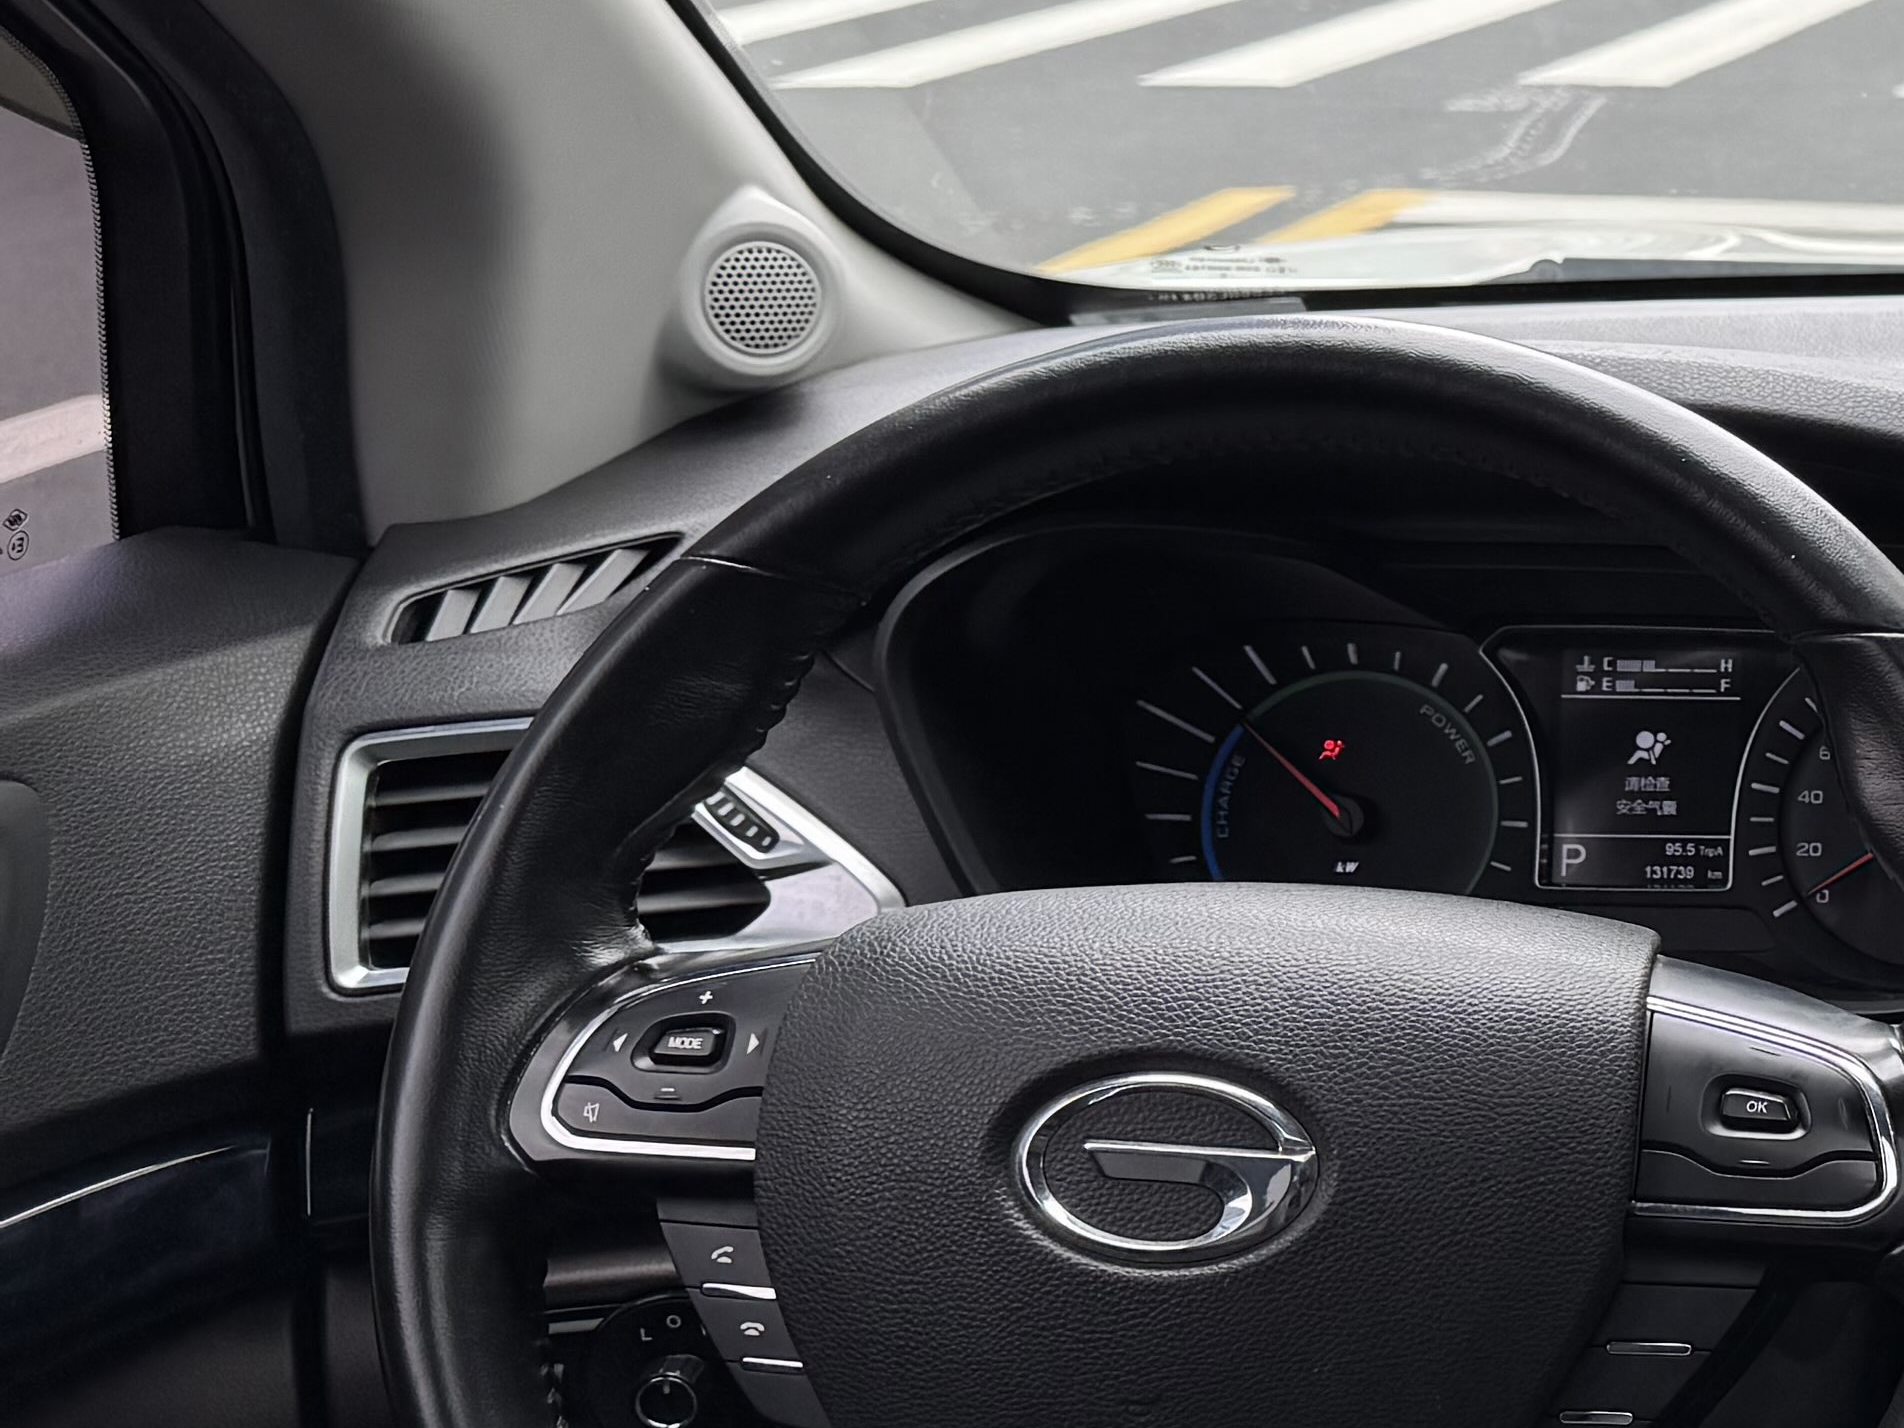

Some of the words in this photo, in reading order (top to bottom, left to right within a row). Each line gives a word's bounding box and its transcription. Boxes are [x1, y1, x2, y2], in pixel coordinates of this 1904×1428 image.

[1602, 656, 1615, 672] C
[1720, 657, 1734, 673] H
[1602, 677, 1614, 692] E
[1720, 678, 1732, 693] F
[1417, 703, 1477, 766] POWER
[1215, 753, 1247, 840] CHARGE
[1797, 789, 1824, 805] 40
[1615, 799, 1678, 816] 安全气囊
[1664, 843, 1696, 857] 95.5
[1795, 842, 1823, 857] 20
[1333, 859, 1359, 874] kW
[1560, 843, 1588, 877] P
[1644, 866, 1695, 880] 131739
[1707, 868, 1723, 880] km
[1815, 888, 1830, 904] 0
[666, 1034, 704, 1052] MODE
[1745, 1099, 1769, 1115] OK
